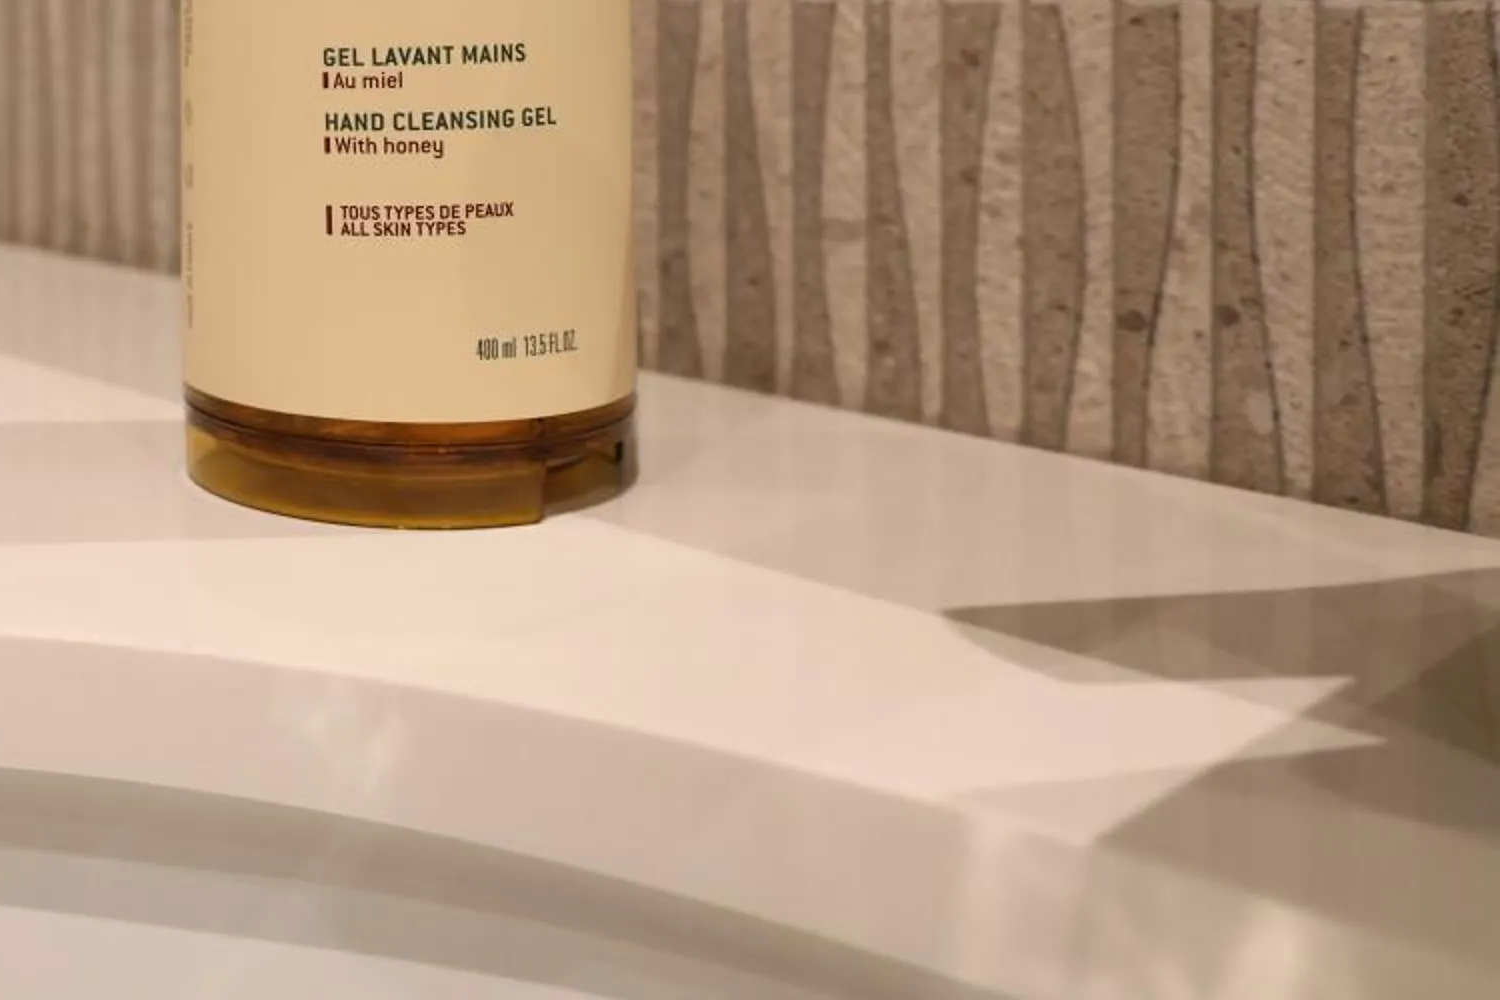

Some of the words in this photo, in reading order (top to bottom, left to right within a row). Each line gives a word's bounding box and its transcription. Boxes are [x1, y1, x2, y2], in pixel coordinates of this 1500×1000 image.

[323, 48, 364, 67] GEL
[372, 46, 454, 67] LAVANT
[462, 43, 526, 64] MAINS
[333, 72, 356, 89] Au
[363, 71, 403, 89] miel
[325, 112, 384, 132] HAND
[393, 109, 515, 131] CLEANSING
[521, 106, 556, 127] GEL
[335, 136, 377, 155] With
[383, 136, 444, 159] honey
[340, 205, 380, 220] TOUS
[384, 205, 435, 220] TYPES
[439, 204, 461, 220] DE
[465, 202, 514, 219] PEAUX
[340, 222, 370, 237] ALL
[373, 221, 411, 237] SKIN
[415, 221, 467, 236] TYPES
[476, 338, 499, 360] 400
[502, 336, 517, 359] ml
